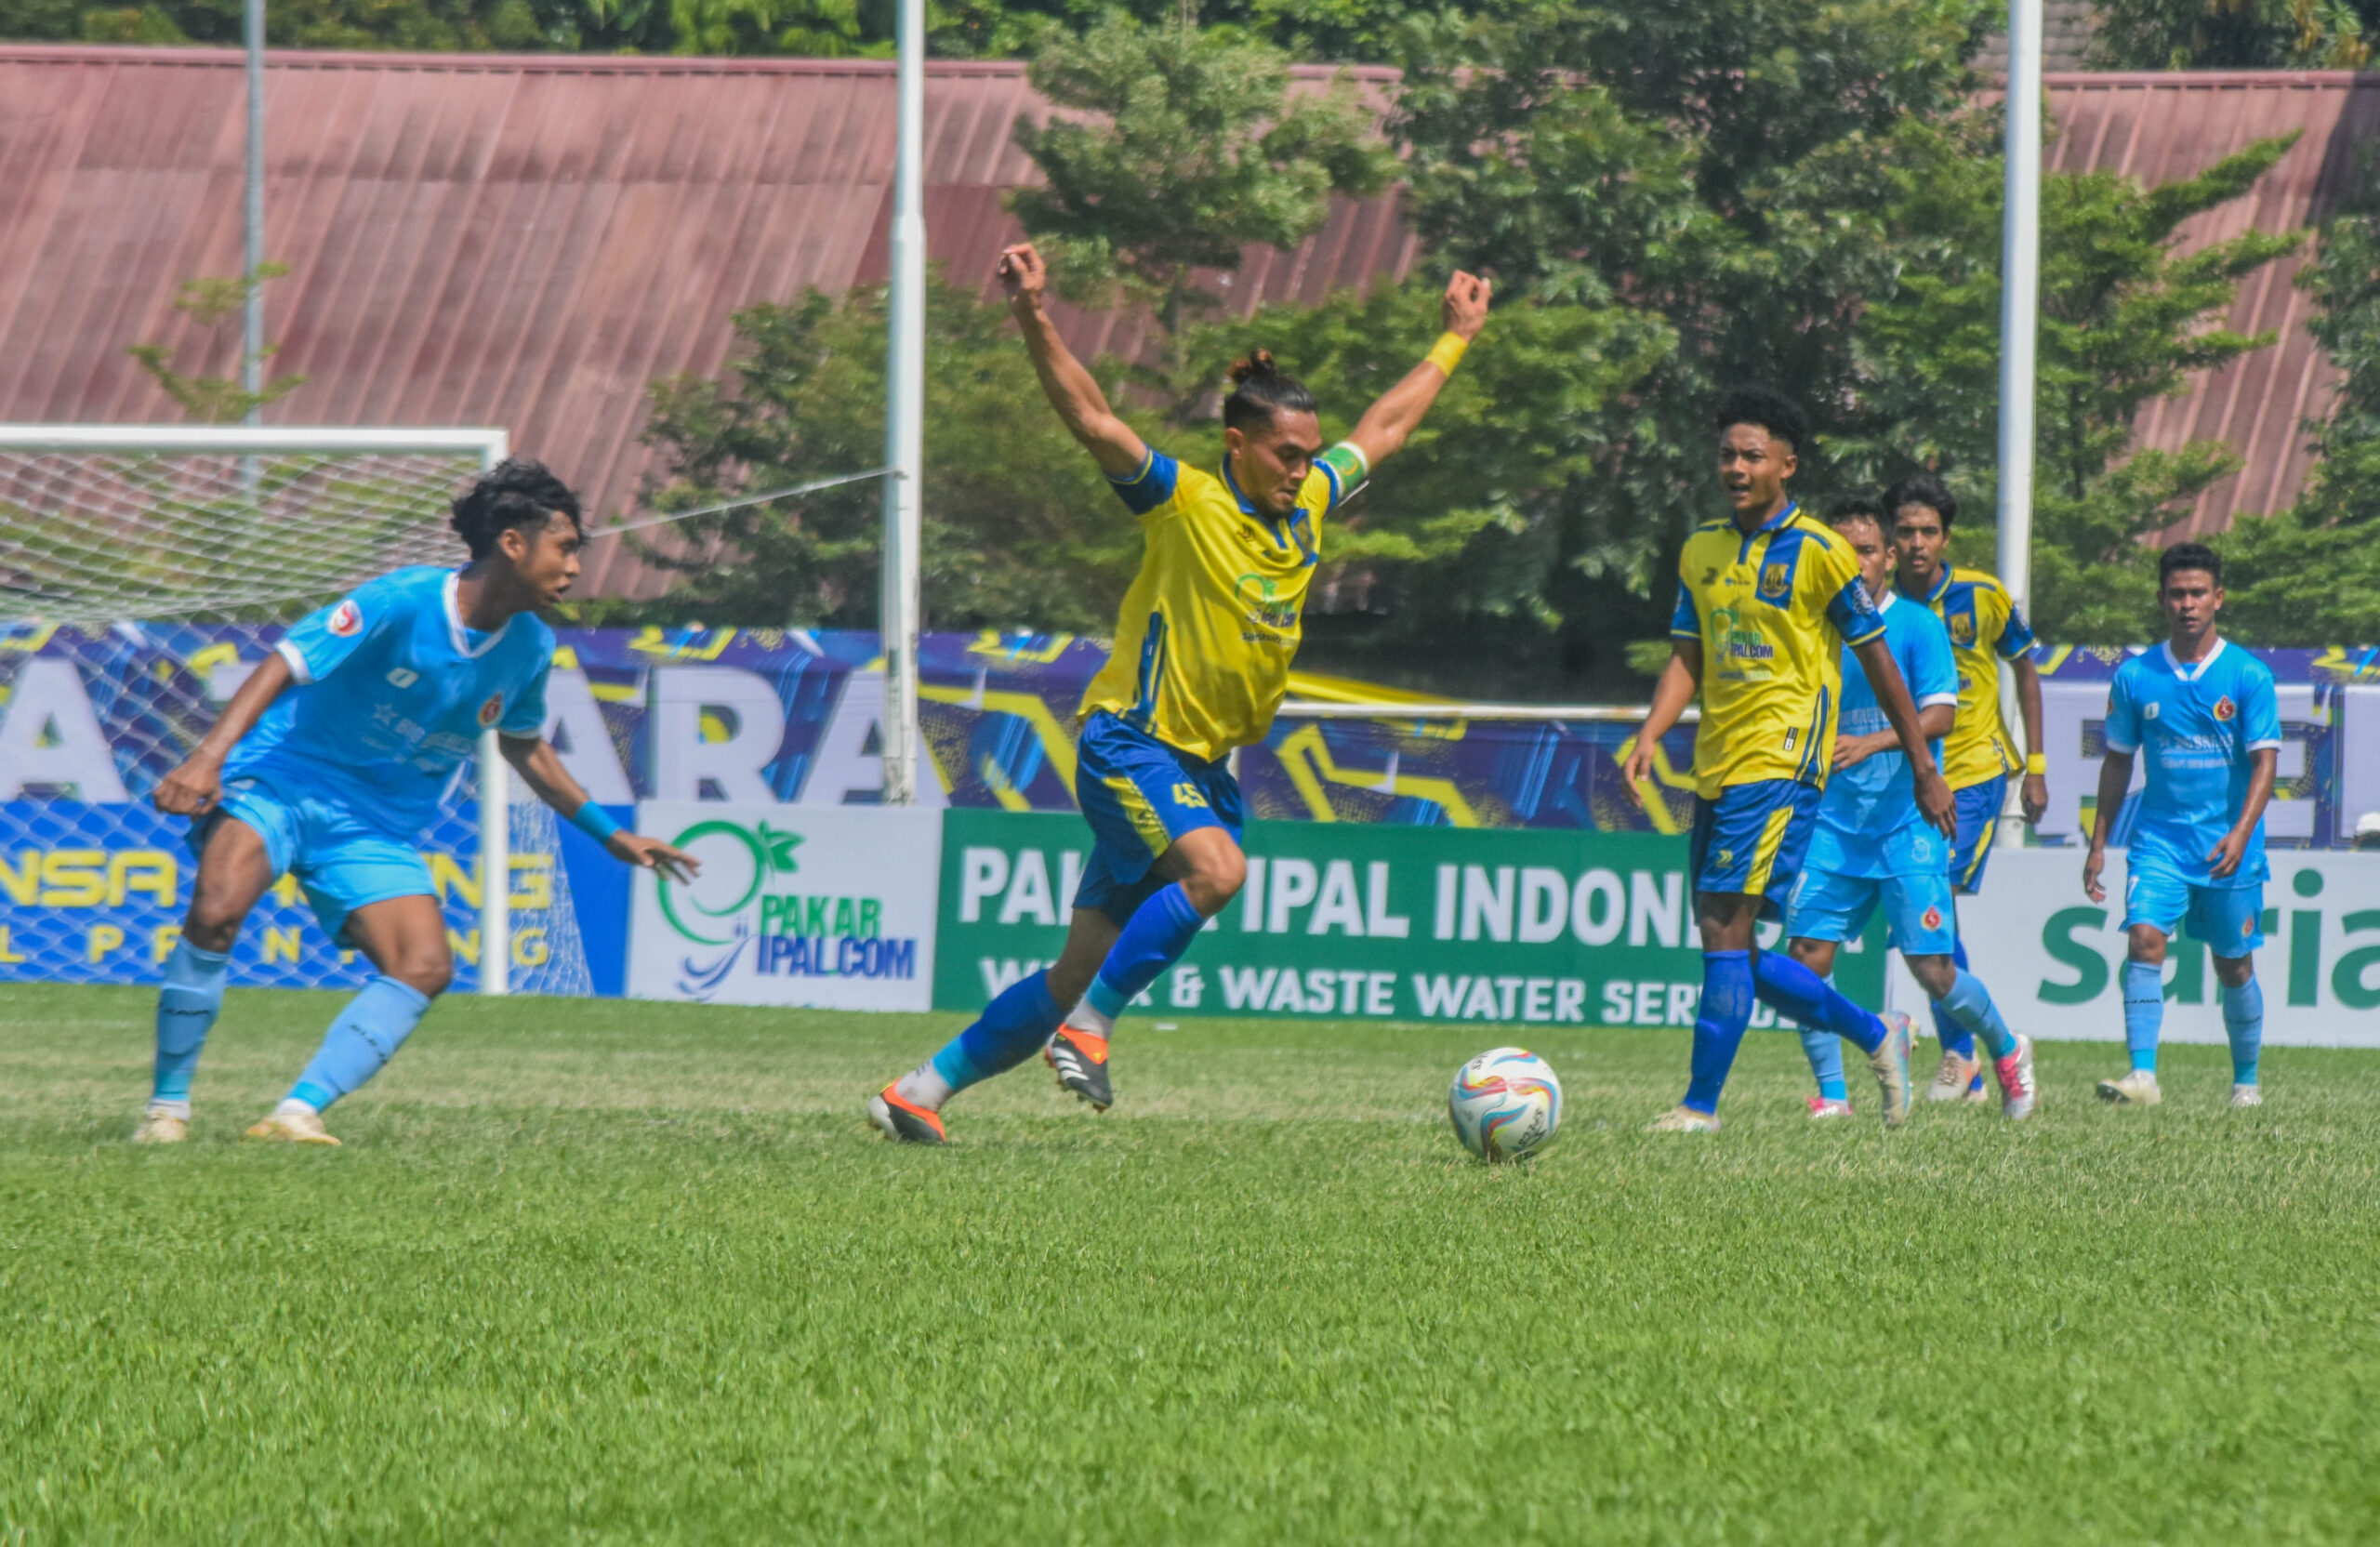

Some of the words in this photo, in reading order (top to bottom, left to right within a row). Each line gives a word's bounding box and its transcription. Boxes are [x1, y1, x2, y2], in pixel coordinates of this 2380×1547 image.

[1172, 782, 1209, 809] 45
[760, 893, 882, 939] PAKAR
[1241, 855, 1410, 939] IPAL
[756, 934, 918, 980] IPAL.COM
[1170, 963, 1205, 1009] &
[1218, 965, 1397, 1015] WASTE
[1413, 973, 1585, 1024] WATER
